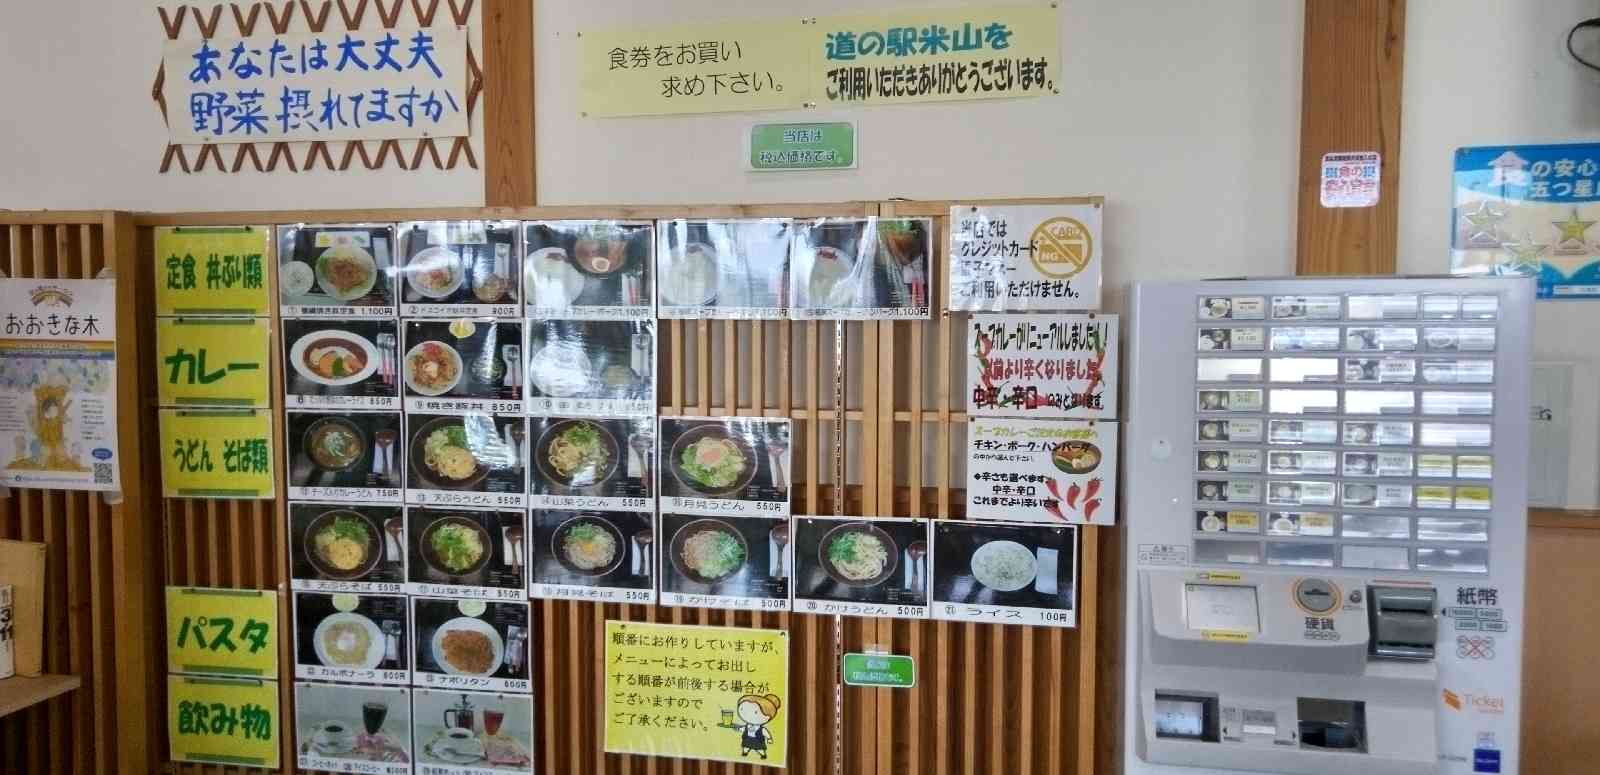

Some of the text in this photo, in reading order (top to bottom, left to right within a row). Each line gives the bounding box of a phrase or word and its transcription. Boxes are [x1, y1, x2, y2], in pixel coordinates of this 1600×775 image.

[826, 22, 1013, 60] 道の駅米山を
[189, 31, 443, 83] あなたは大丈夫
[608, 41, 742, 70] 食券をお買い
[662, 72, 784, 98] 求め下さい。
[826, 58, 1055, 101] ご利用いただきありがとうございます。
[1531, 179, 1600, 198] 五つ星
[962, 219, 1008, 238] 当店では
[962, 240, 1039, 258] クレジットカード
[166, 253, 263, 289] 定食 丼ぶり類
[5, 313, 101, 337] おおきな木
[165, 348, 260, 384] カレー
[491, 402, 522, 412] 850円
[173, 438, 268, 473] うどん そば類
[622, 498, 647, 508] 550円
[756, 502, 782, 513] 550円
[1456, 586, 1498, 606] 紙幣
[896, 606, 924, 617] 500円
[967, 607, 1024, 620] ライス
[1040, 611, 1068, 623] 100円
[176, 616, 270, 654] パスタ
[612, 632, 780, 654] 順番にお作りしていますが、
[614, 652, 757, 673] メニューによってお出し
[320, 668, 376, 679] カルボナーラ
[438, 674, 491, 688] ナポリタン
[612, 672, 770, 694] する順番が前後する場合が
[613, 692, 704, 710] ございますので
[177, 699, 271, 741] 飲み物
[613, 711, 709, 732] ご了承ください。
